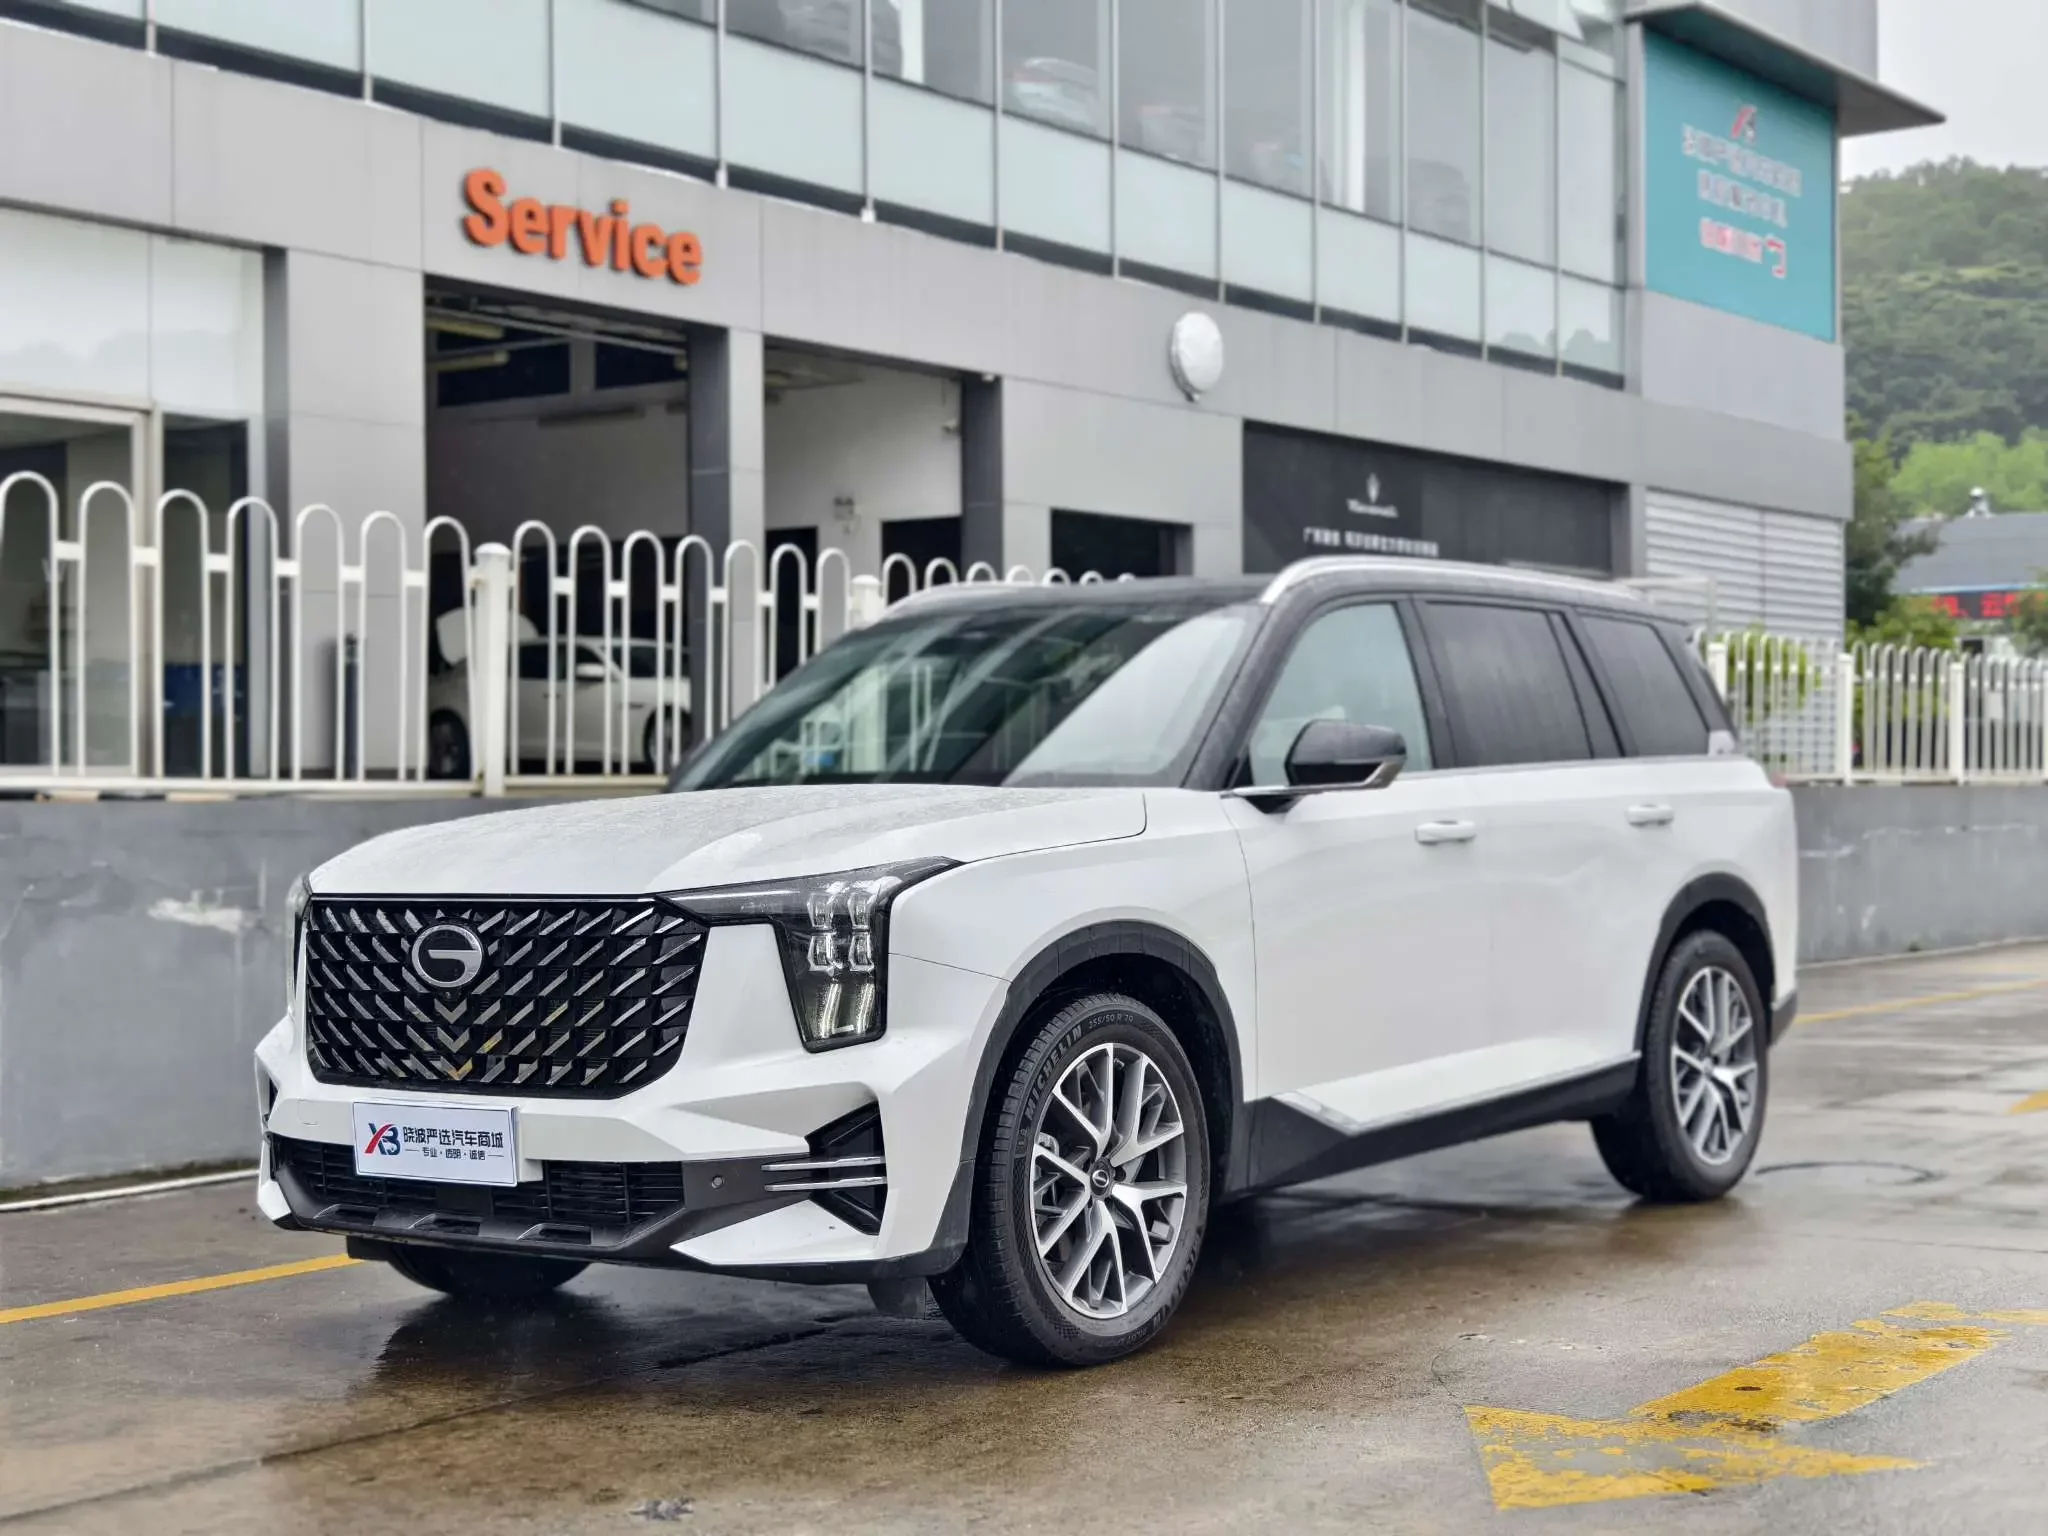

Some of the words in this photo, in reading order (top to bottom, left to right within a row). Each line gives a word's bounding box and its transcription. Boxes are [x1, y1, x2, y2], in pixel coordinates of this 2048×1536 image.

[462, 167, 704, 286] Service
[1024, 1024, 1083, 1121] MICHELIN
[402, 1126, 504, 1149] 晓波严选汽车商城
